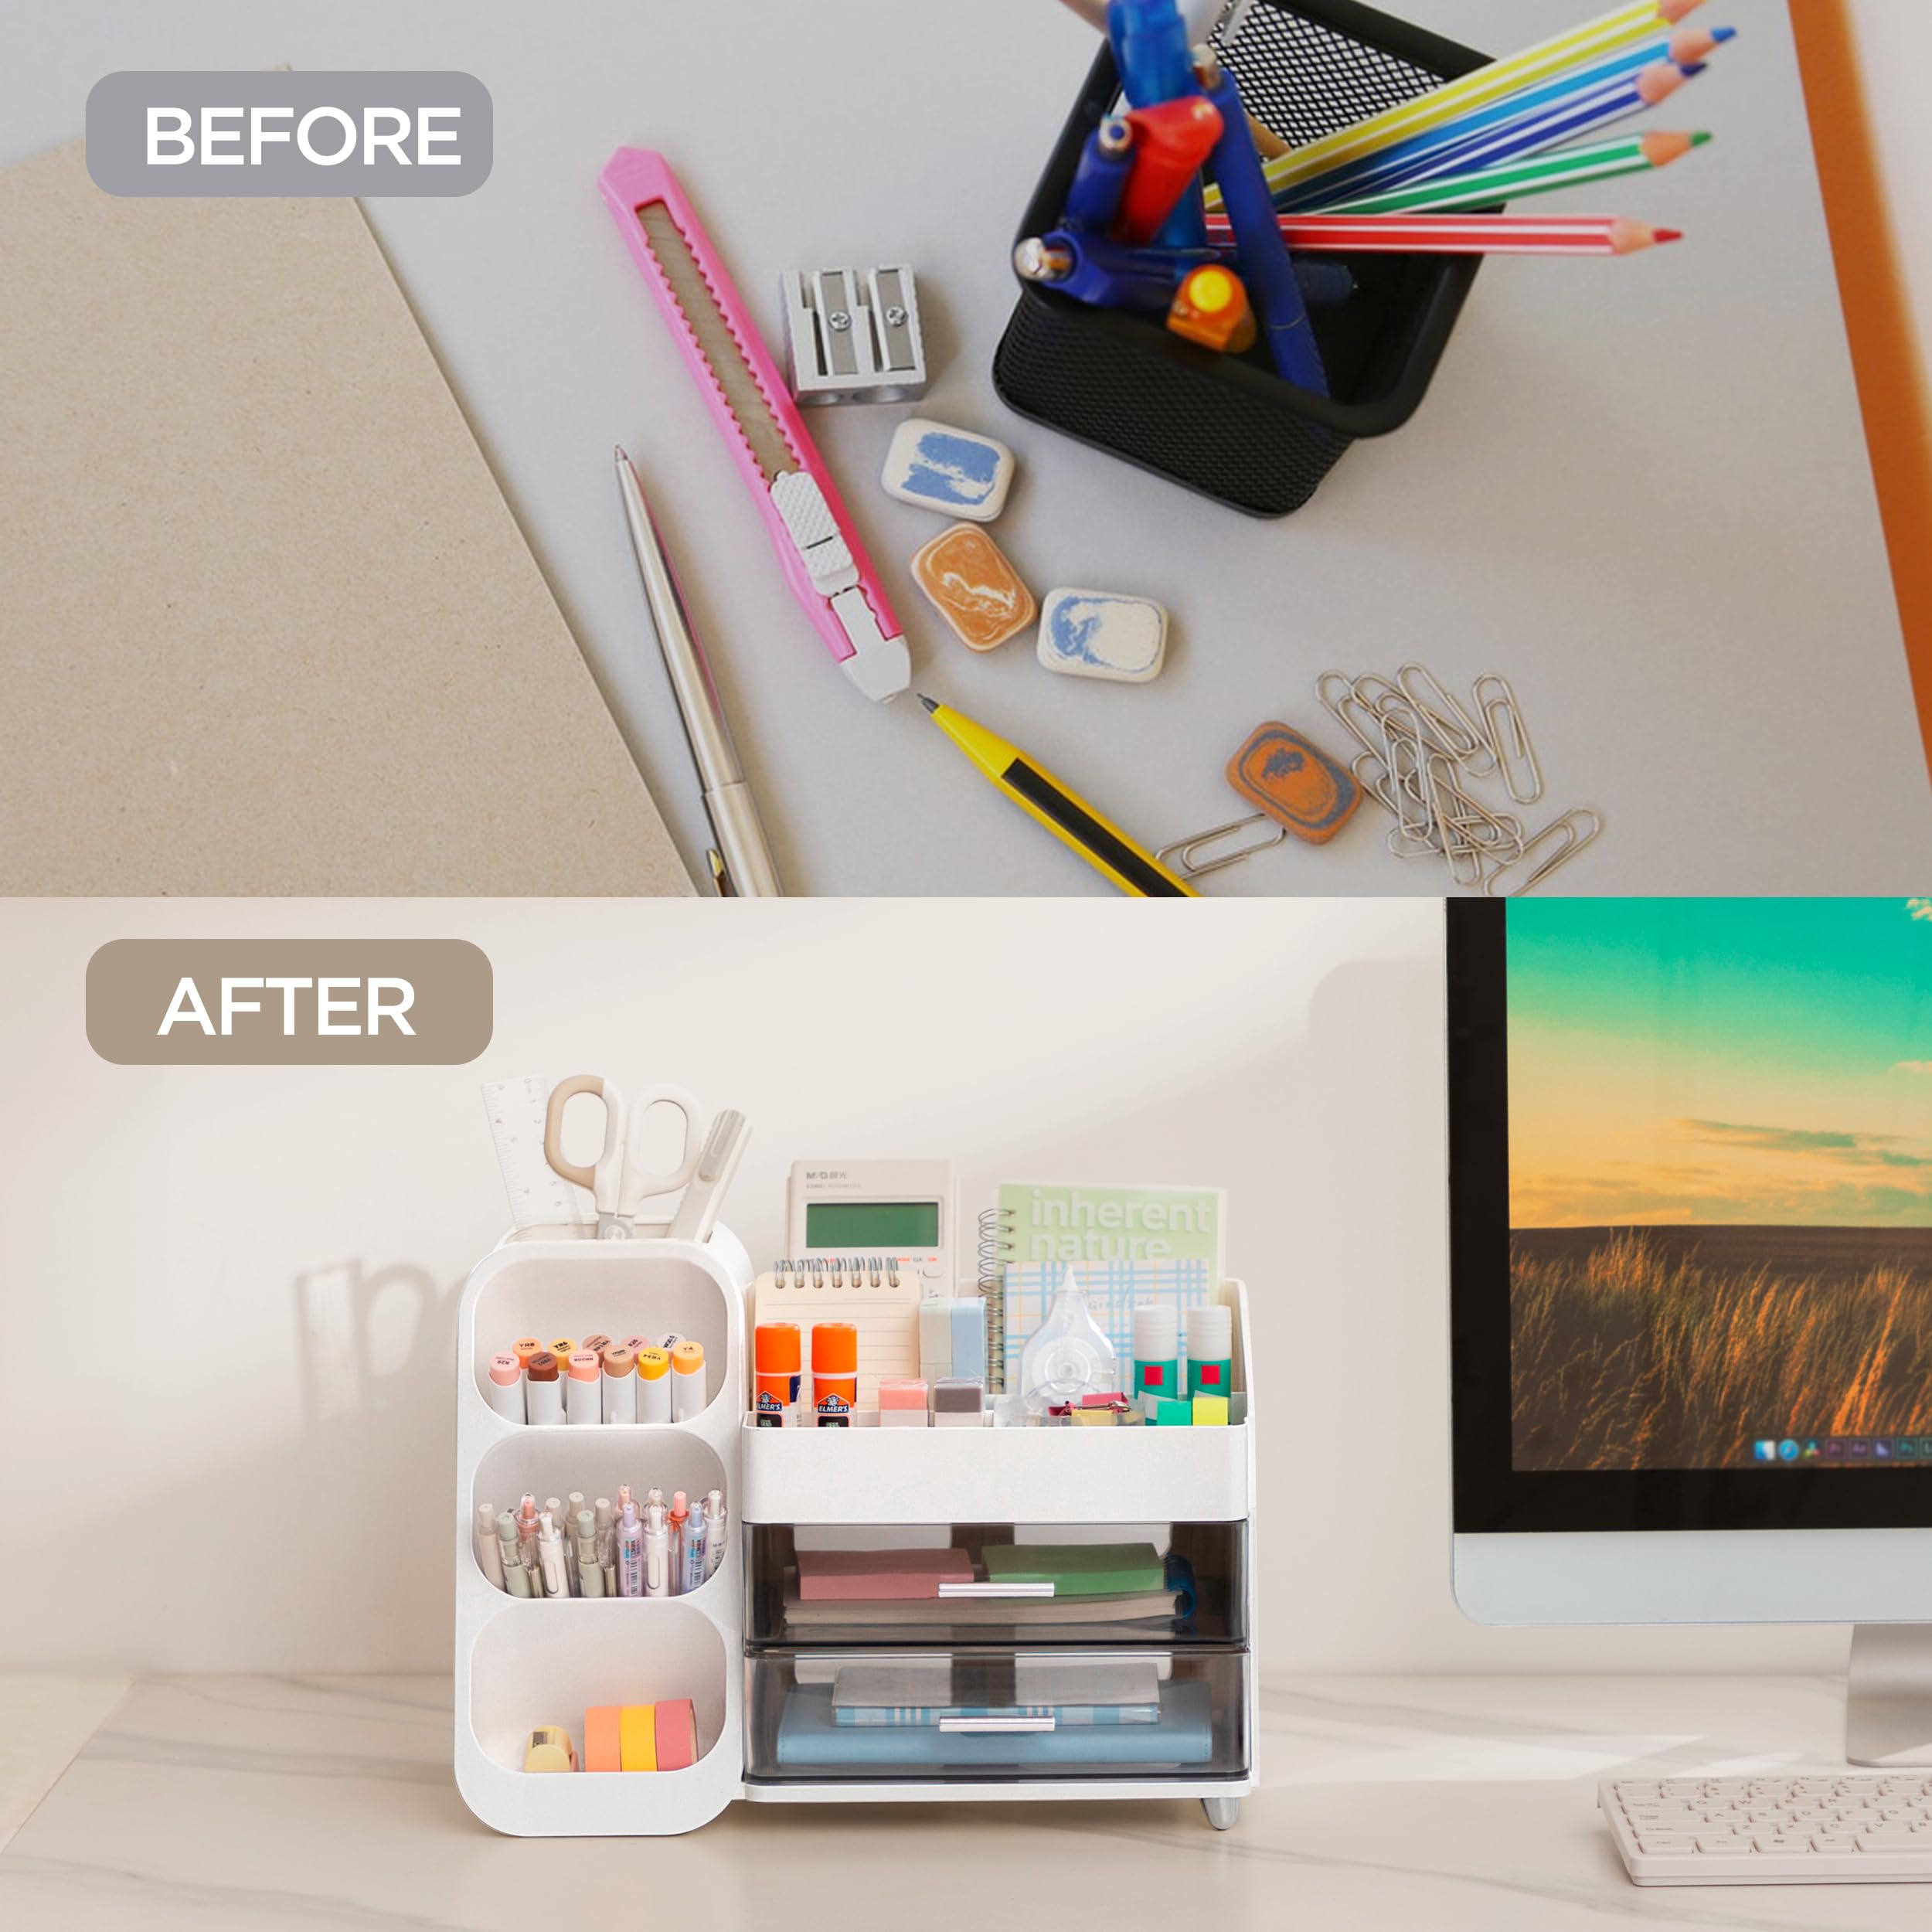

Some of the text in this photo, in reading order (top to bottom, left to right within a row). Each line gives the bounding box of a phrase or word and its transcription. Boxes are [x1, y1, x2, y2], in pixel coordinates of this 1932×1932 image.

[1030, 1189, 1212, 1233] inherent
[1029, 1228, 1171, 1261] nature
[818, 1404, 849, 1413] ELMER'S
